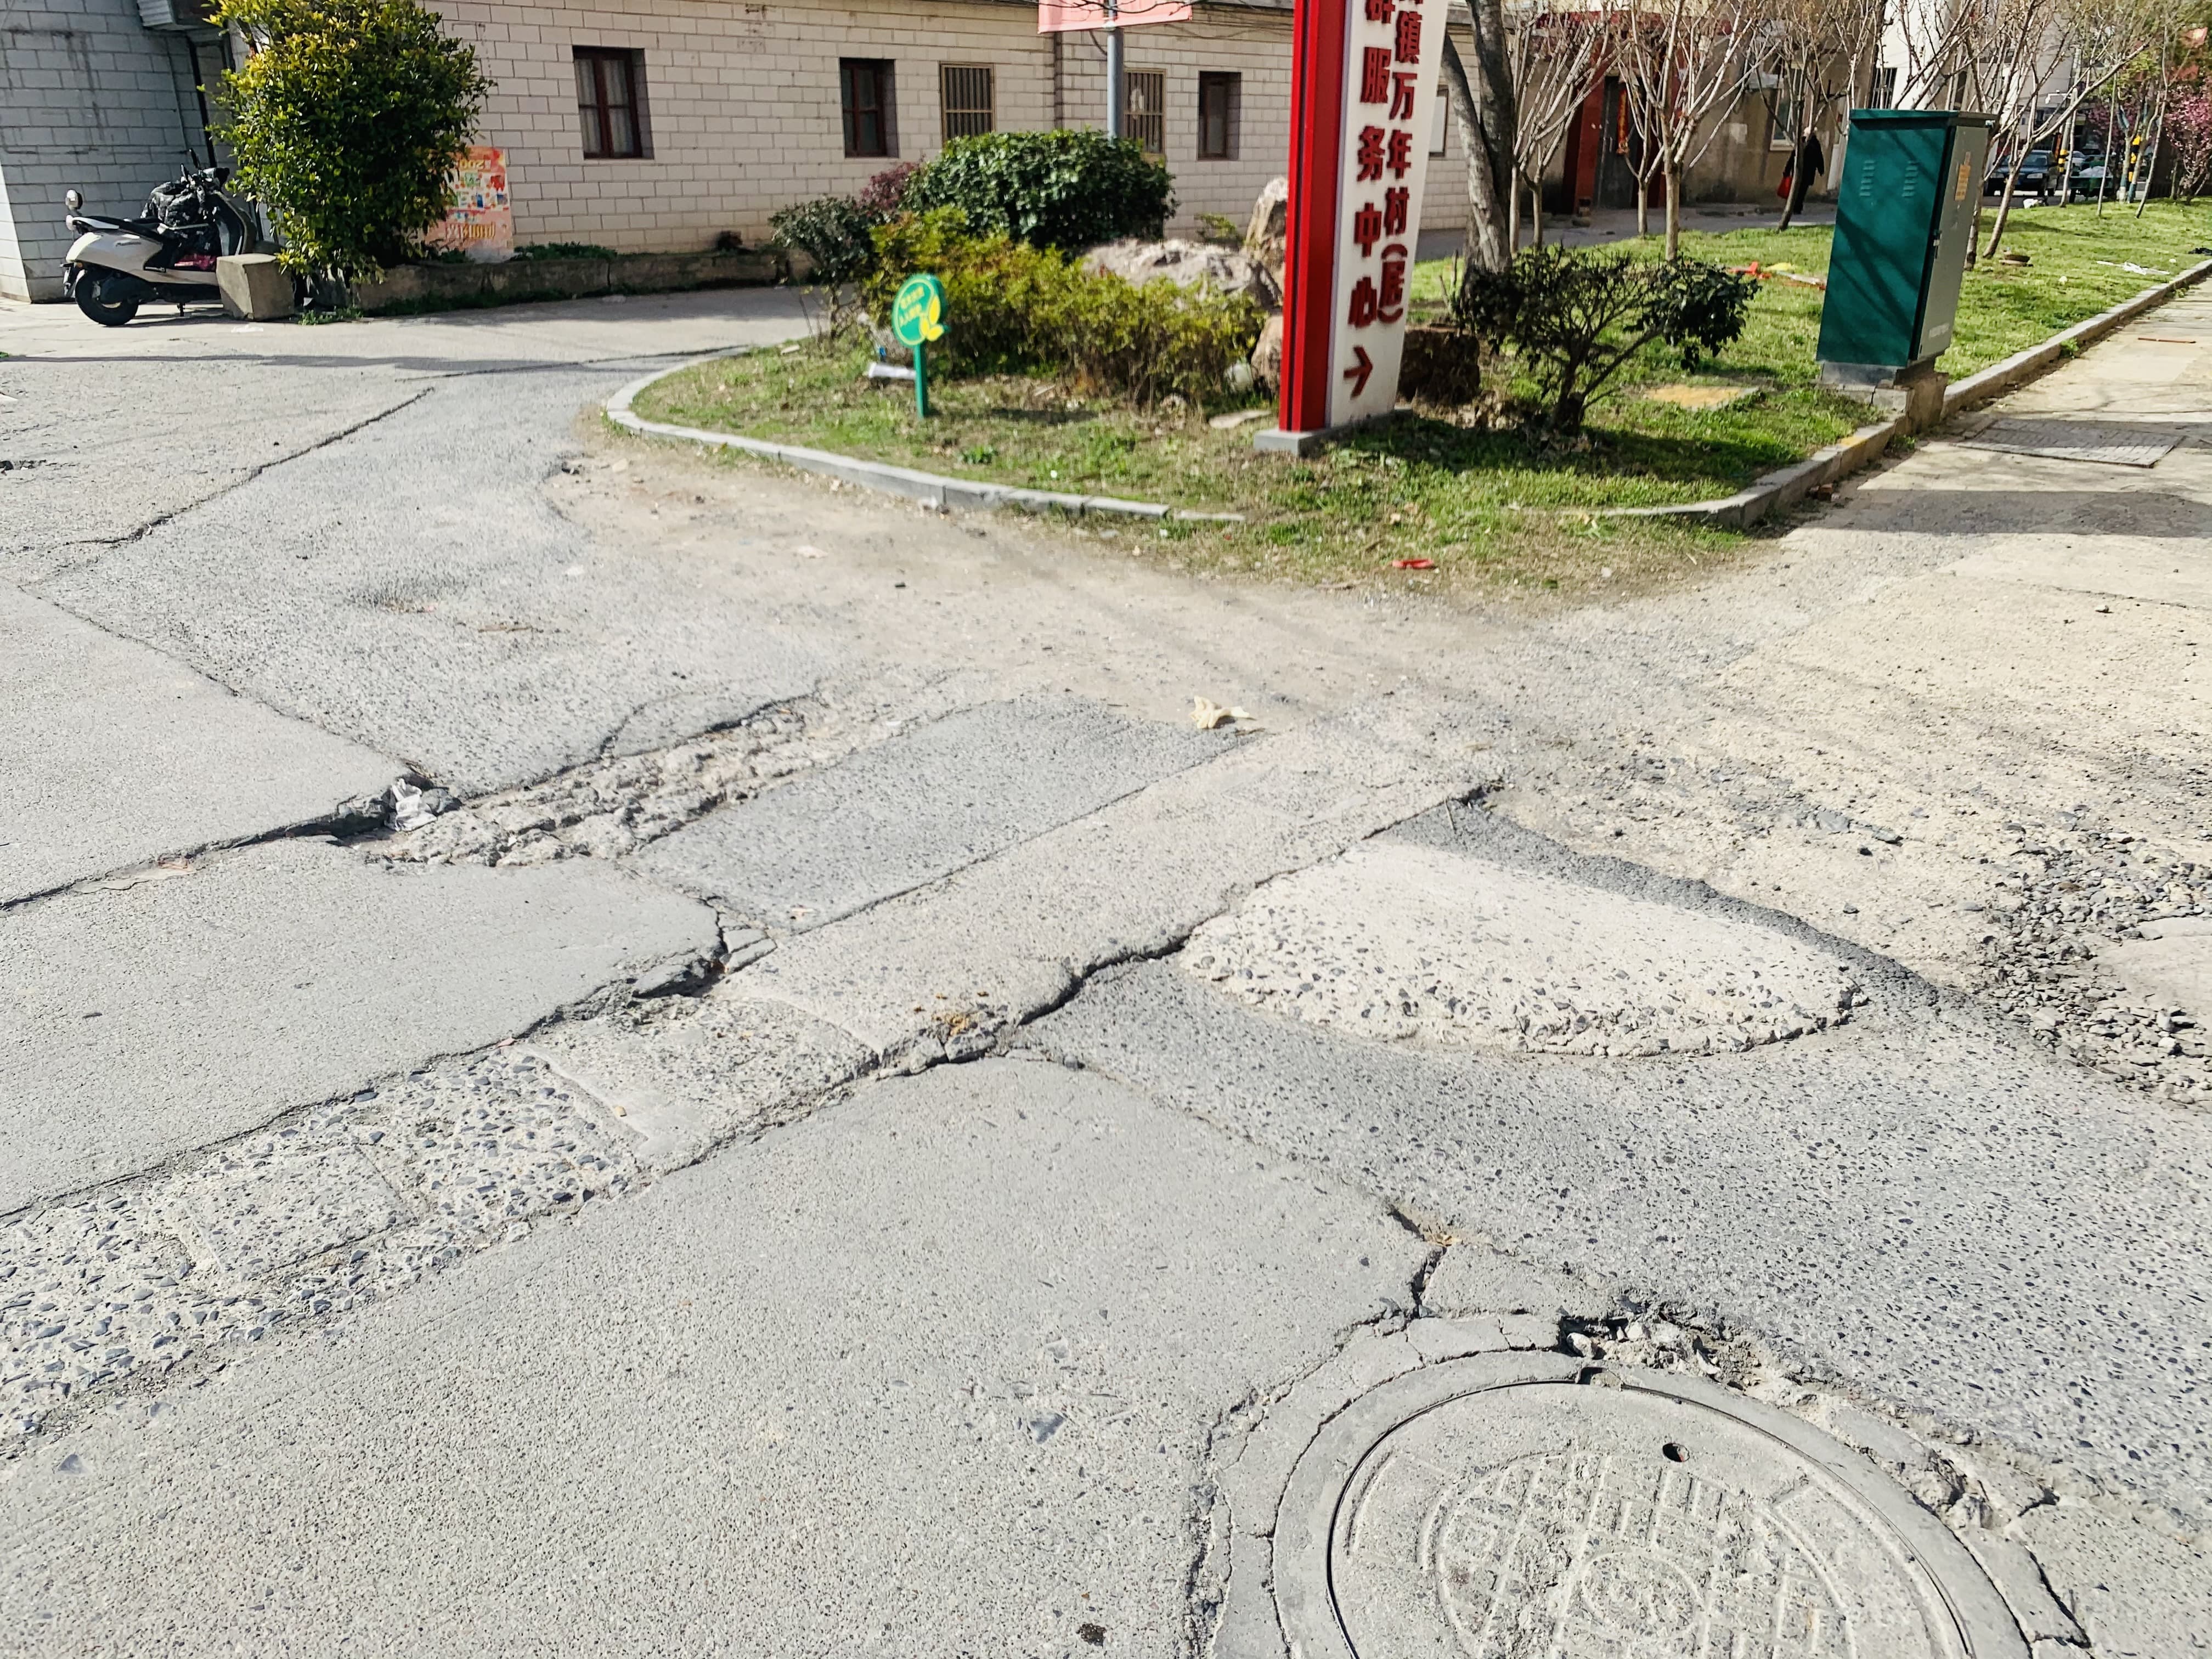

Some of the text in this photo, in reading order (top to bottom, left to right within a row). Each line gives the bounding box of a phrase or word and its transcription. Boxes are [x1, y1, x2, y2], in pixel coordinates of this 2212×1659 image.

[1378, 0, 1423, 323] 镇万年村（居）
